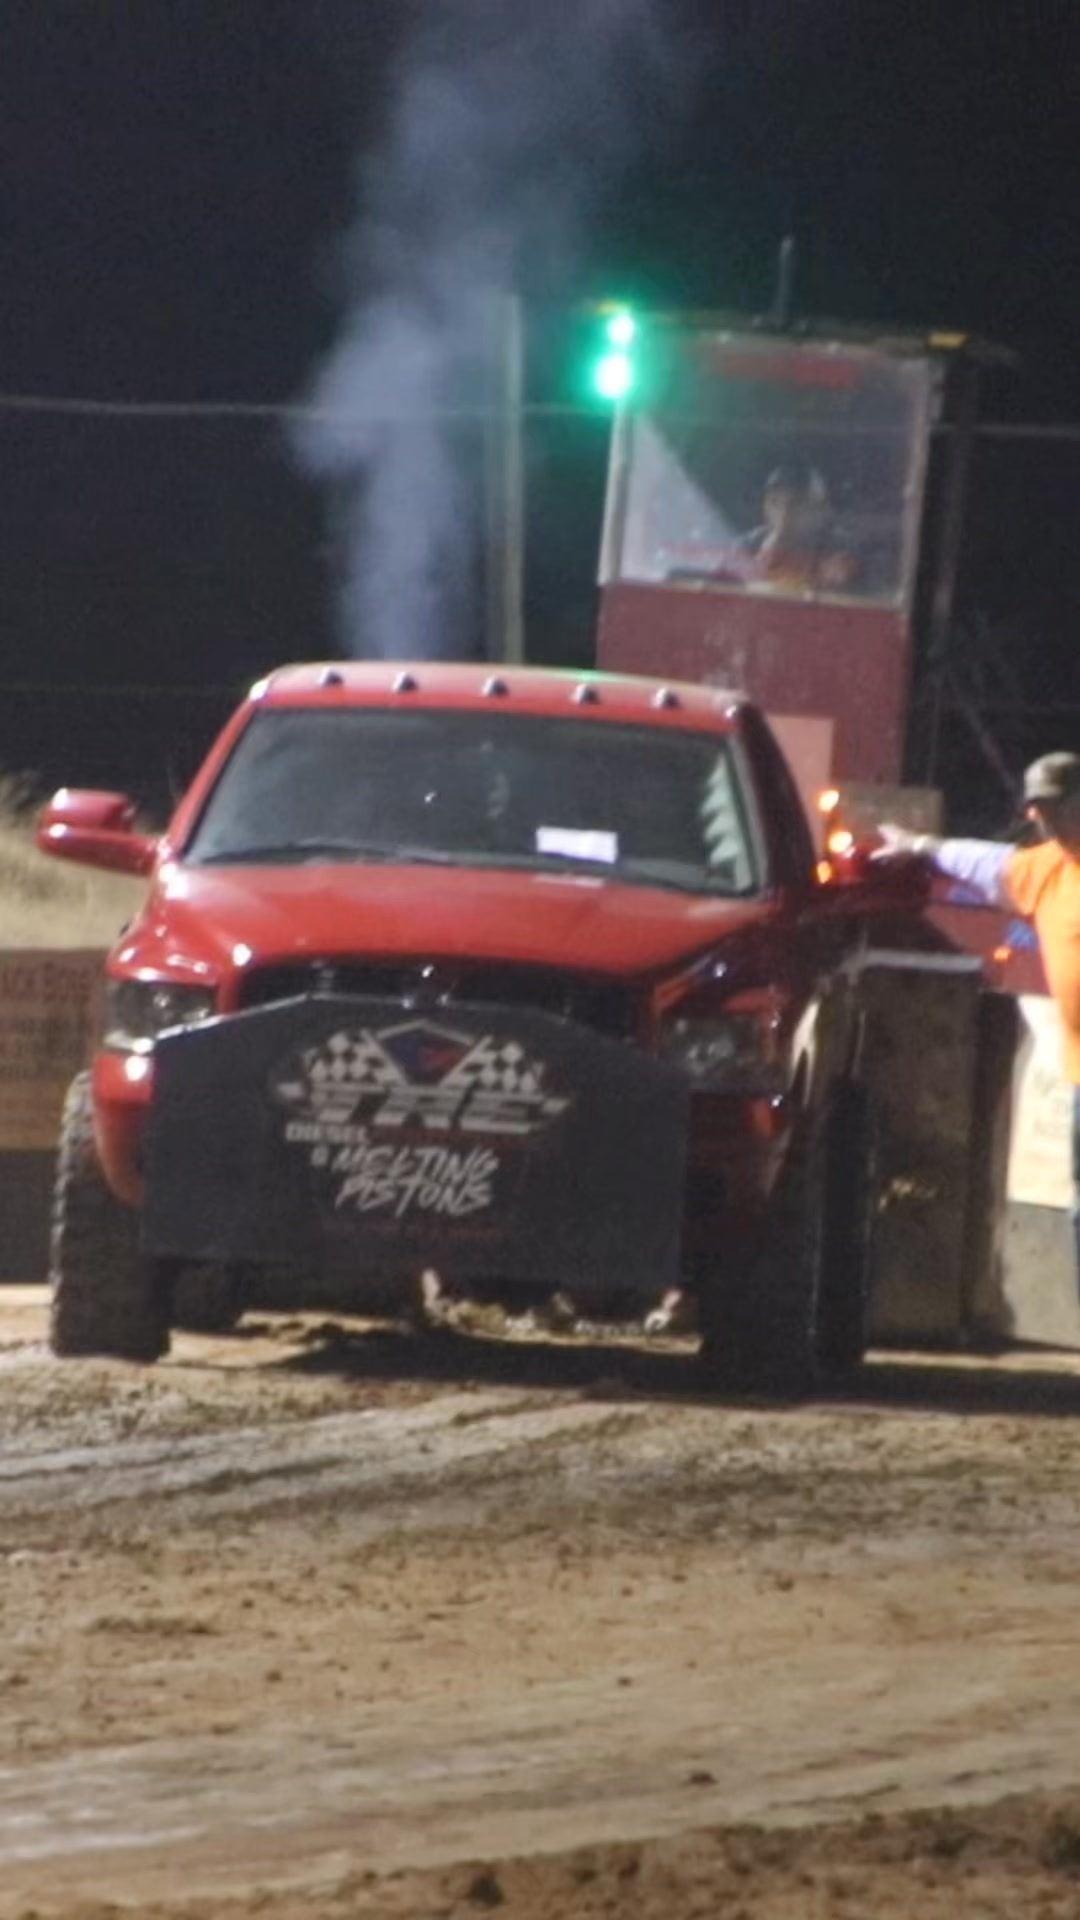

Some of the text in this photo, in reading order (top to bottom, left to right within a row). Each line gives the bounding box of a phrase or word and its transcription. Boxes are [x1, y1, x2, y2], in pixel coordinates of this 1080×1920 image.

[284, 1121, 371, 1146] DIESEL
[331, 1145, 499, 1185] MELTING
[334, 1172, 493, 1218] PISTONS
